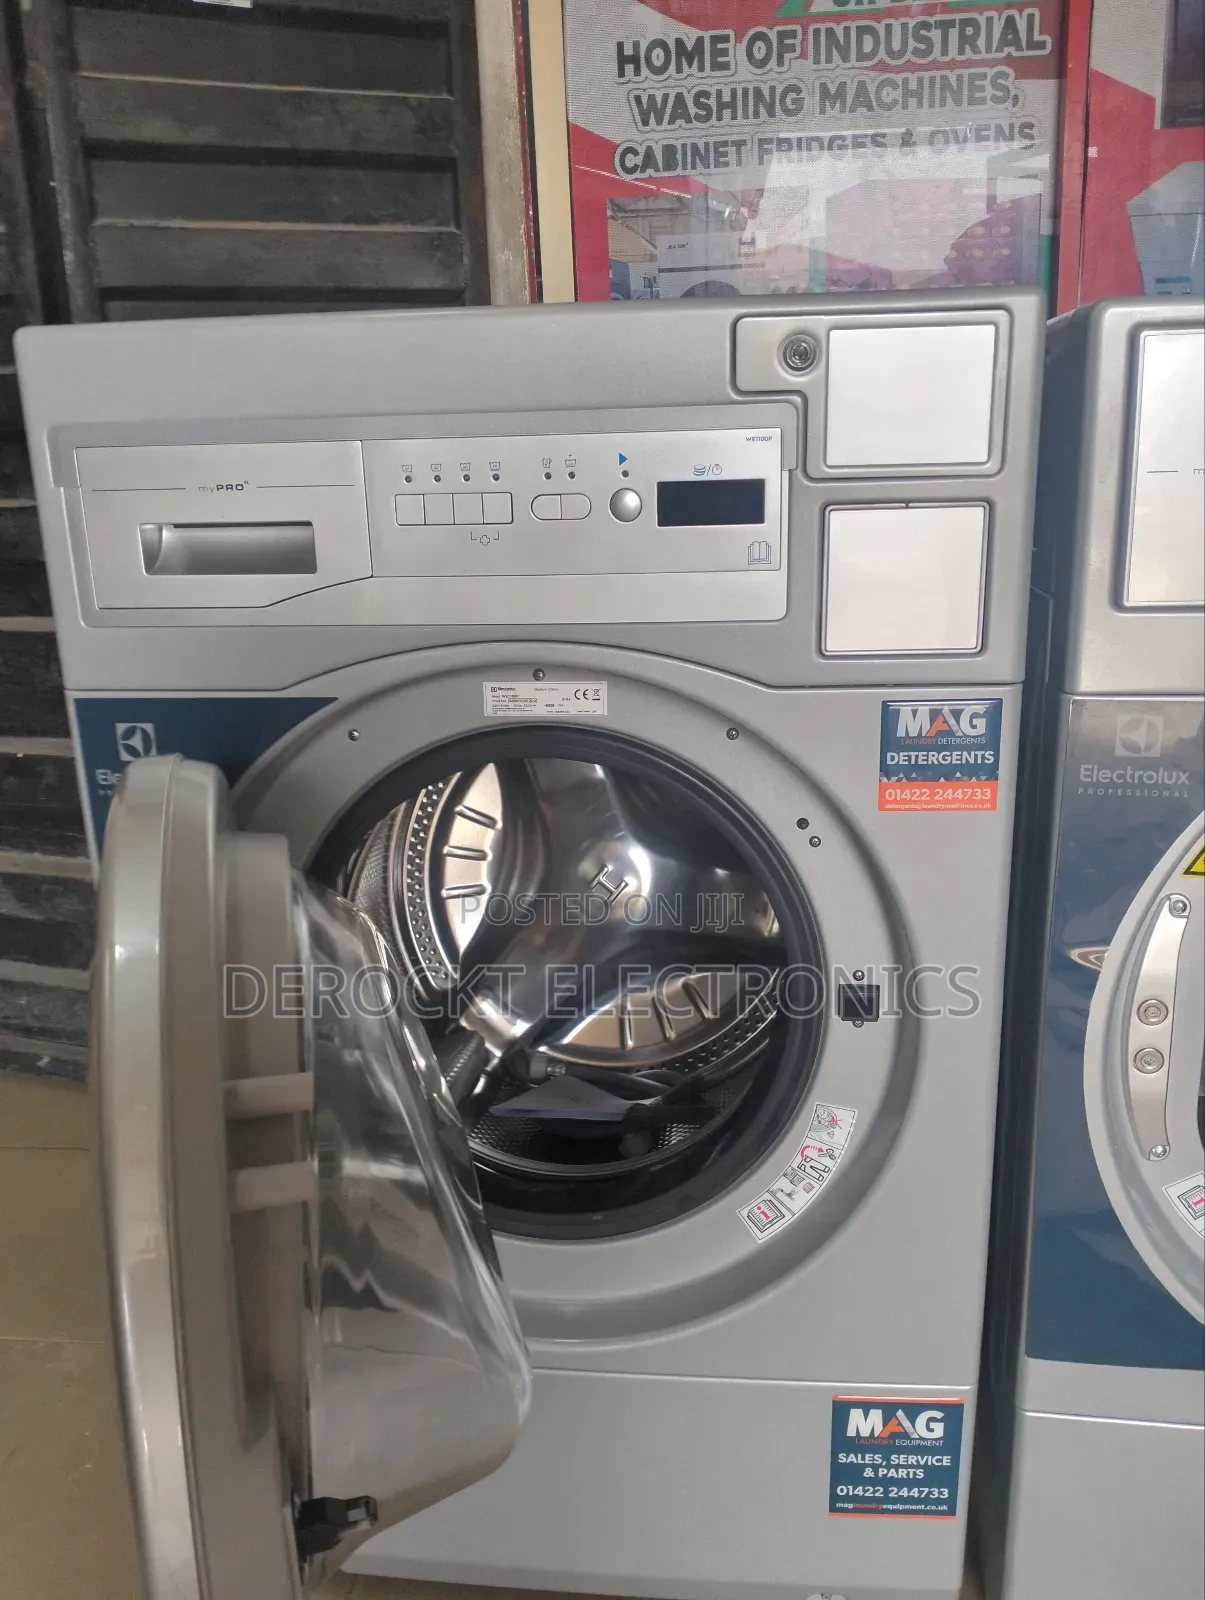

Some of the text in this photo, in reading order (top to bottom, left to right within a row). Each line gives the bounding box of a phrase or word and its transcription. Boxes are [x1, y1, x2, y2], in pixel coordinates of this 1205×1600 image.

[616, 12, 1048, 78] HOME OF INDUSTRIAL
[633, 70, 1020, 127] WASHING MACHINES,
[618, 121, 1036, 175] CABINET FRIDGES & OVENS
[896, 705, 987, 738] MAG
[937, 736, 986, 745] DETERGENTS
[886, 750, 995, 765] DETERGENTS
[1079, 764, 1190, 785] Electrolux
[885, 788, 992, 801] 01422 244733
[1078, 787, 1189, 798] PROFESSIONAL
[846, 1408, 945, 1439] MAG
[855, 1437, 944, 1447] LAUNDRY EQUIPMENT
[838, 1453, 951, 1466] SALES, SERVICE
[863, 1467, 925, 1479] & PARTS
[836, 1485, 949, 1499] 01422 244733
